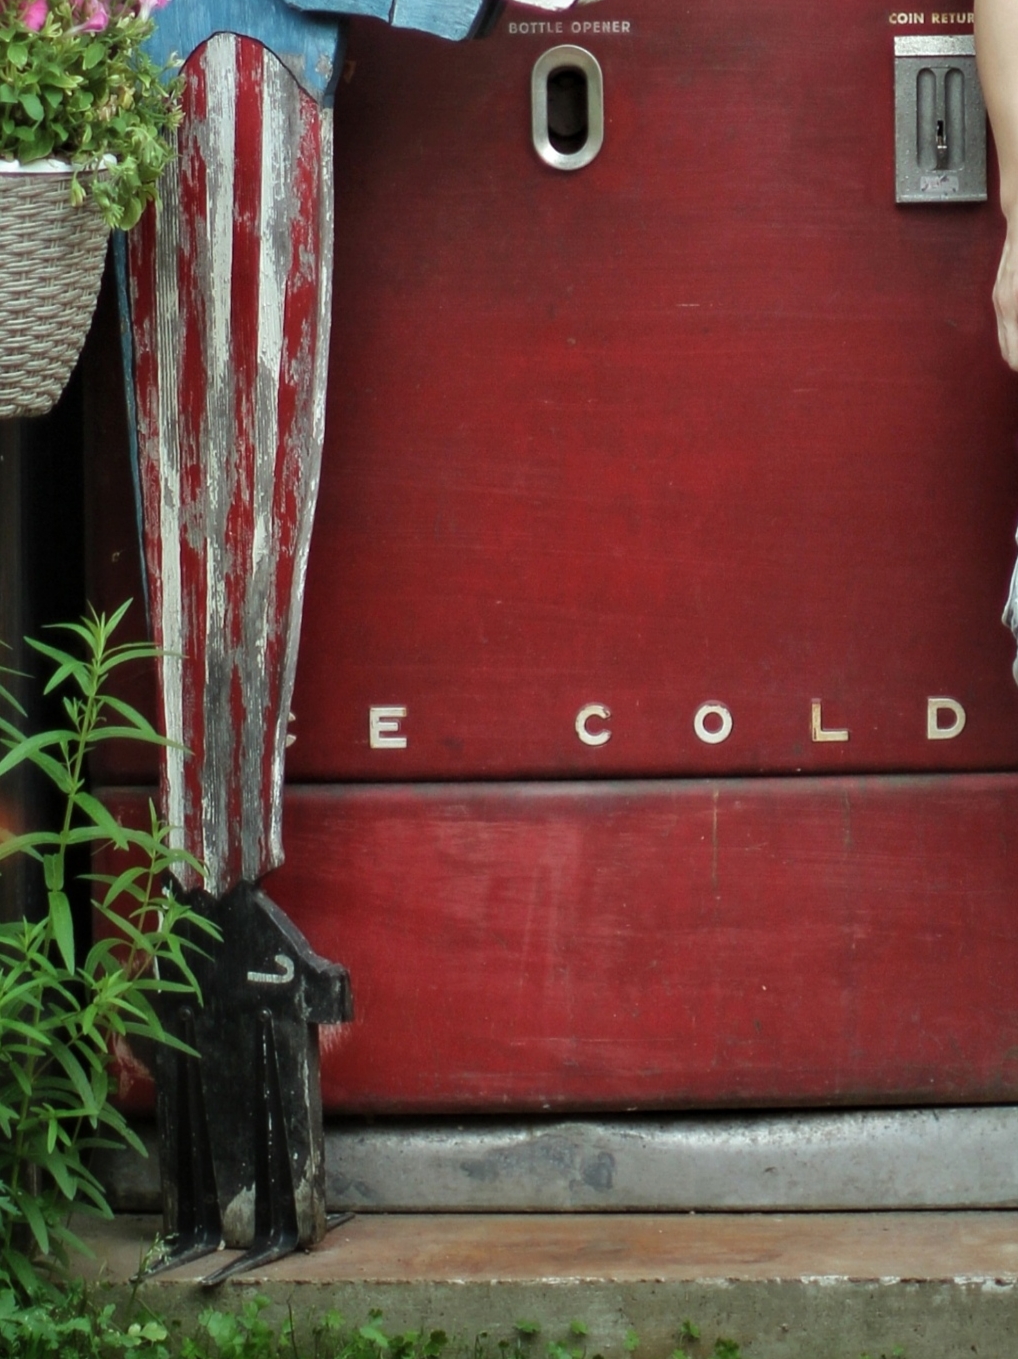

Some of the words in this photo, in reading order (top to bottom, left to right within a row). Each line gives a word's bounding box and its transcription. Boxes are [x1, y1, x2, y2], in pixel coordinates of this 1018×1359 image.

[888, 12, 925, 24] COIN
[931, 12, 974, 24] RETUR
[508, 22, 564, 35] BOTTLE
[571, 20, 631, 34] OPENER
[575, 696, 967, 745] COLD
